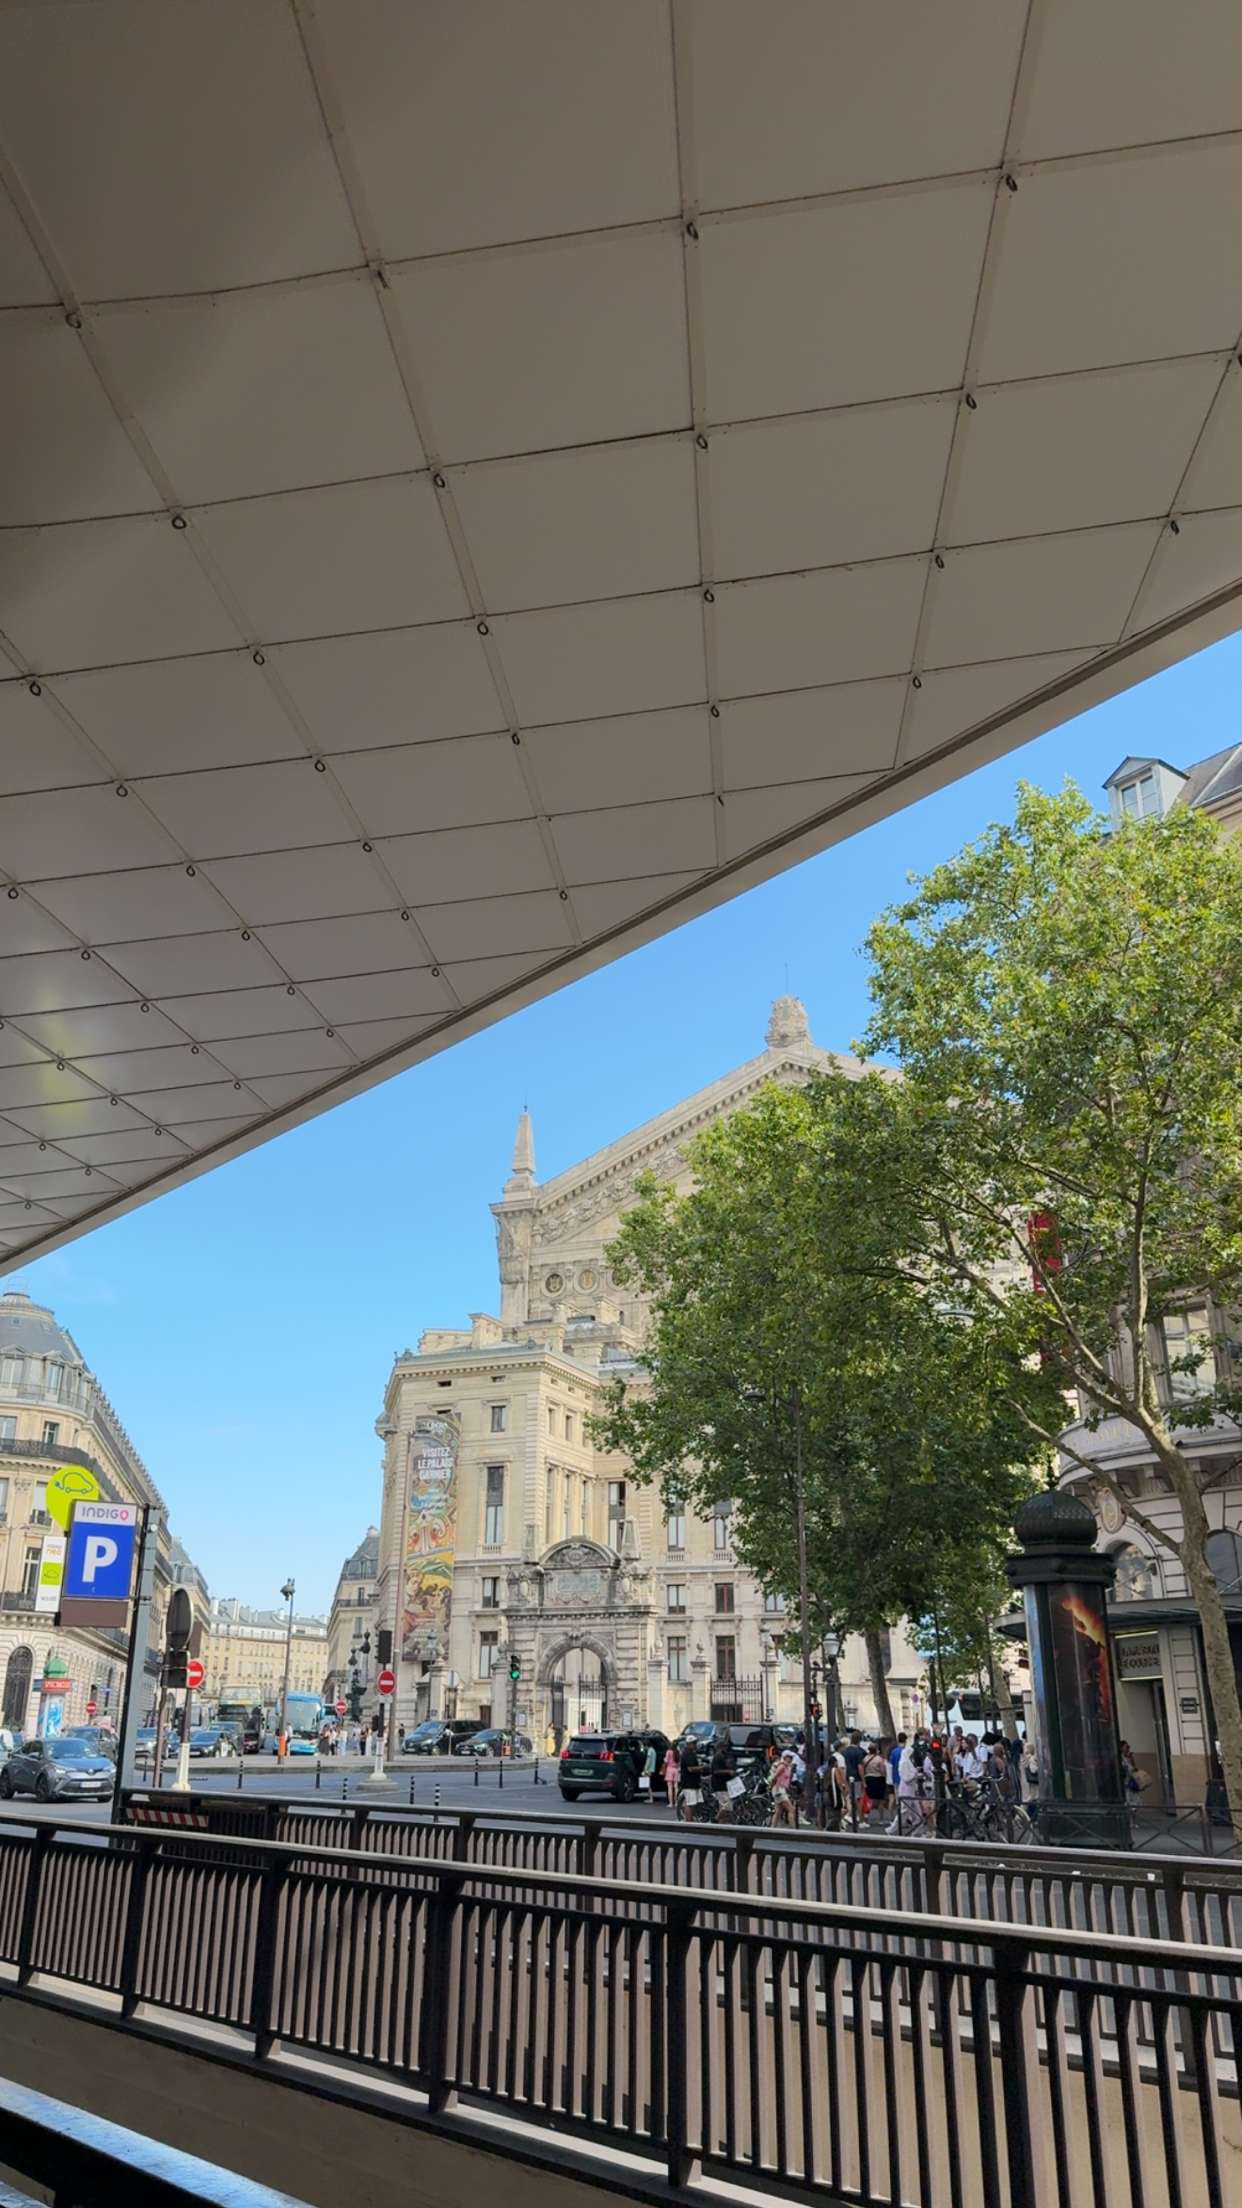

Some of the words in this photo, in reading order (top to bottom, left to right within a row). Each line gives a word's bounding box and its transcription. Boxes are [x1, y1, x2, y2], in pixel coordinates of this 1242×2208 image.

[422, 1447, 450, 1457] VISITEZ
[417, 1458, 428, 1469] LE
[428, 1456, 454, 1468] PALAIS
[82, 1506, 129, 1520] INDIGO
[82, 1535, 118, 1583] P
